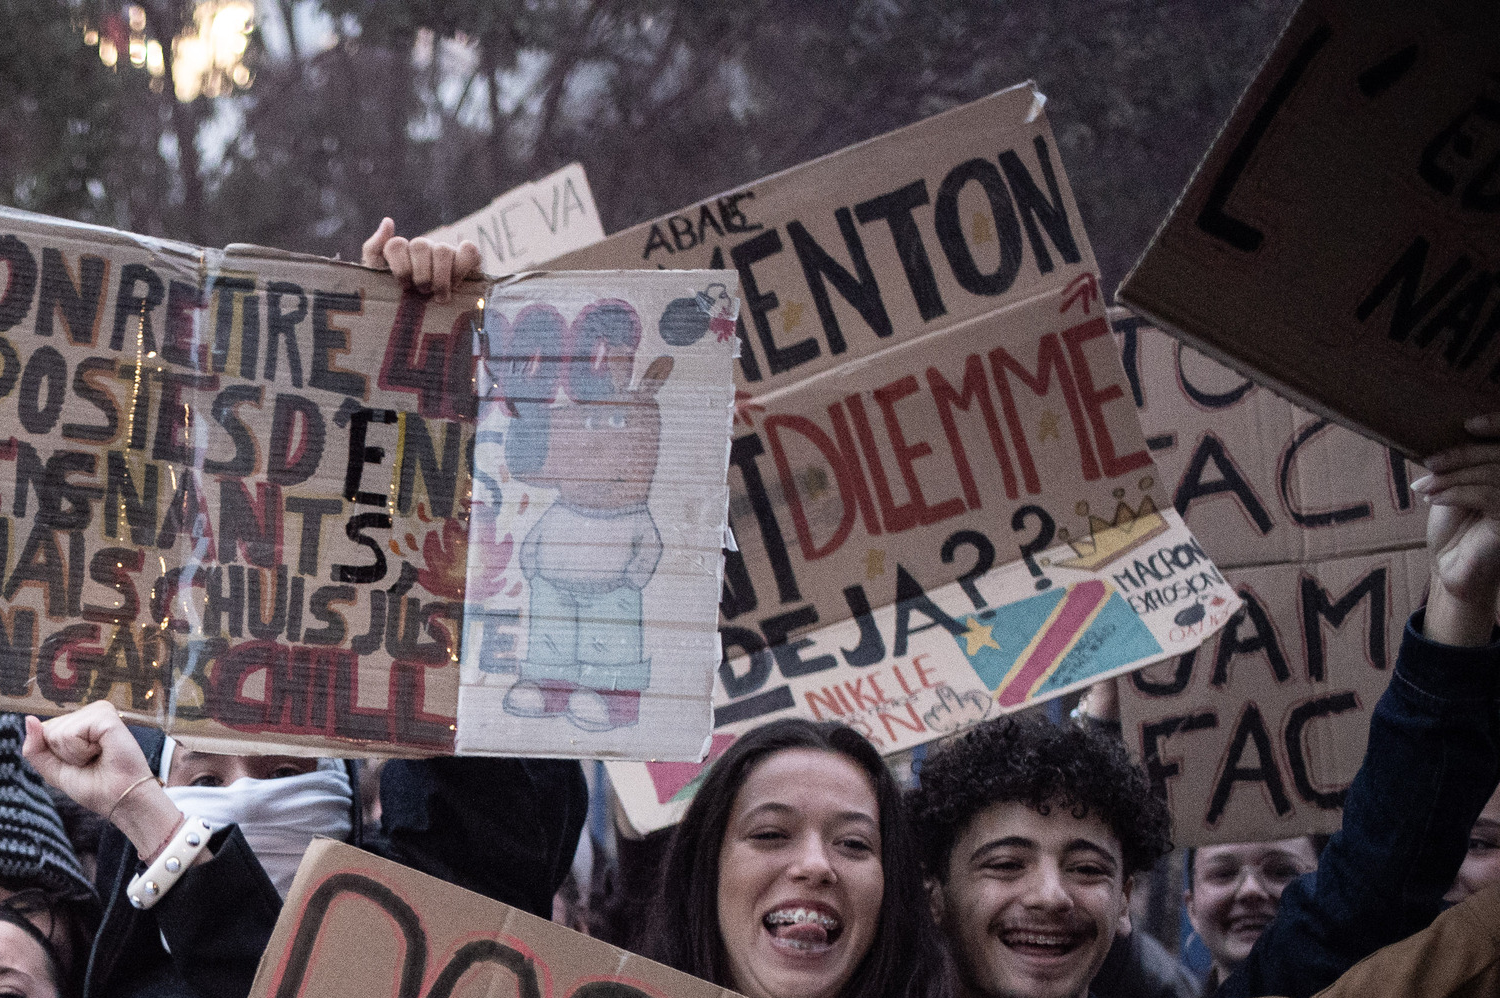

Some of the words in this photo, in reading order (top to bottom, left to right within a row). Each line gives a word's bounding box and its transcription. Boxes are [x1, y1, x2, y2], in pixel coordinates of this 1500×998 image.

[532, 176, 587, 235] VA
[109, 262, 371, 401] RETIRE
[764, 314, 1153, 562] DILEMME
[1112, 537, 1209, 593] MACRON
[892, 653, 941, 696] LE
